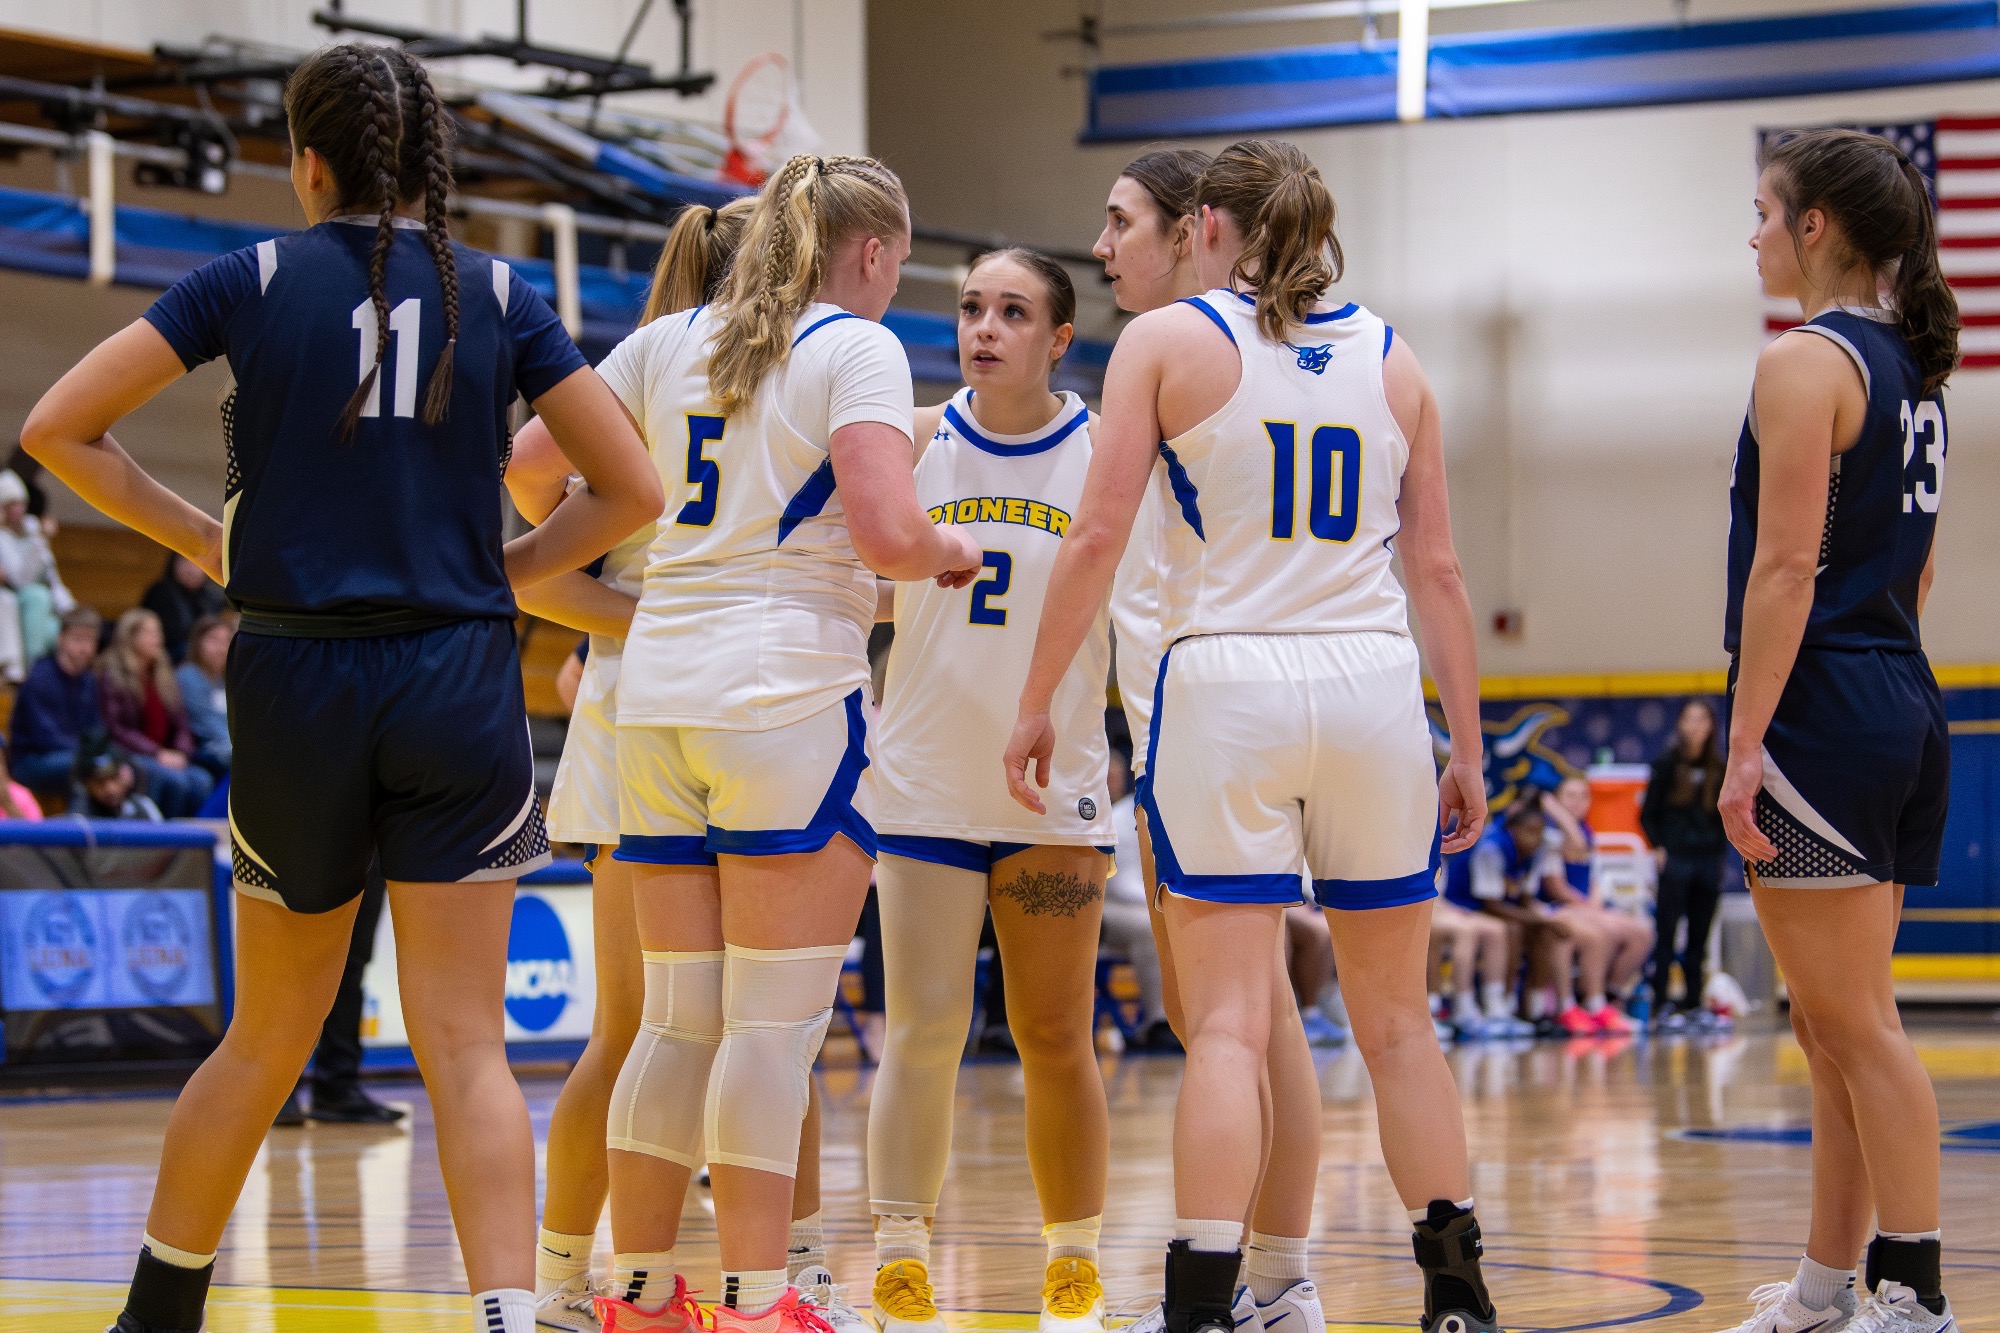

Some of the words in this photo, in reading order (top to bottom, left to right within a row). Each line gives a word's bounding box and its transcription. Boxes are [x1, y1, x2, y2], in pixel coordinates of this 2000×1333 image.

[352, 296, 421, 418] 11
[674, 411, 729, 530] 5
[1260, 419, 1363, 545] 10
[1901, 399, 1945, 513] 23
[967, 549, 1014, 628] 2
